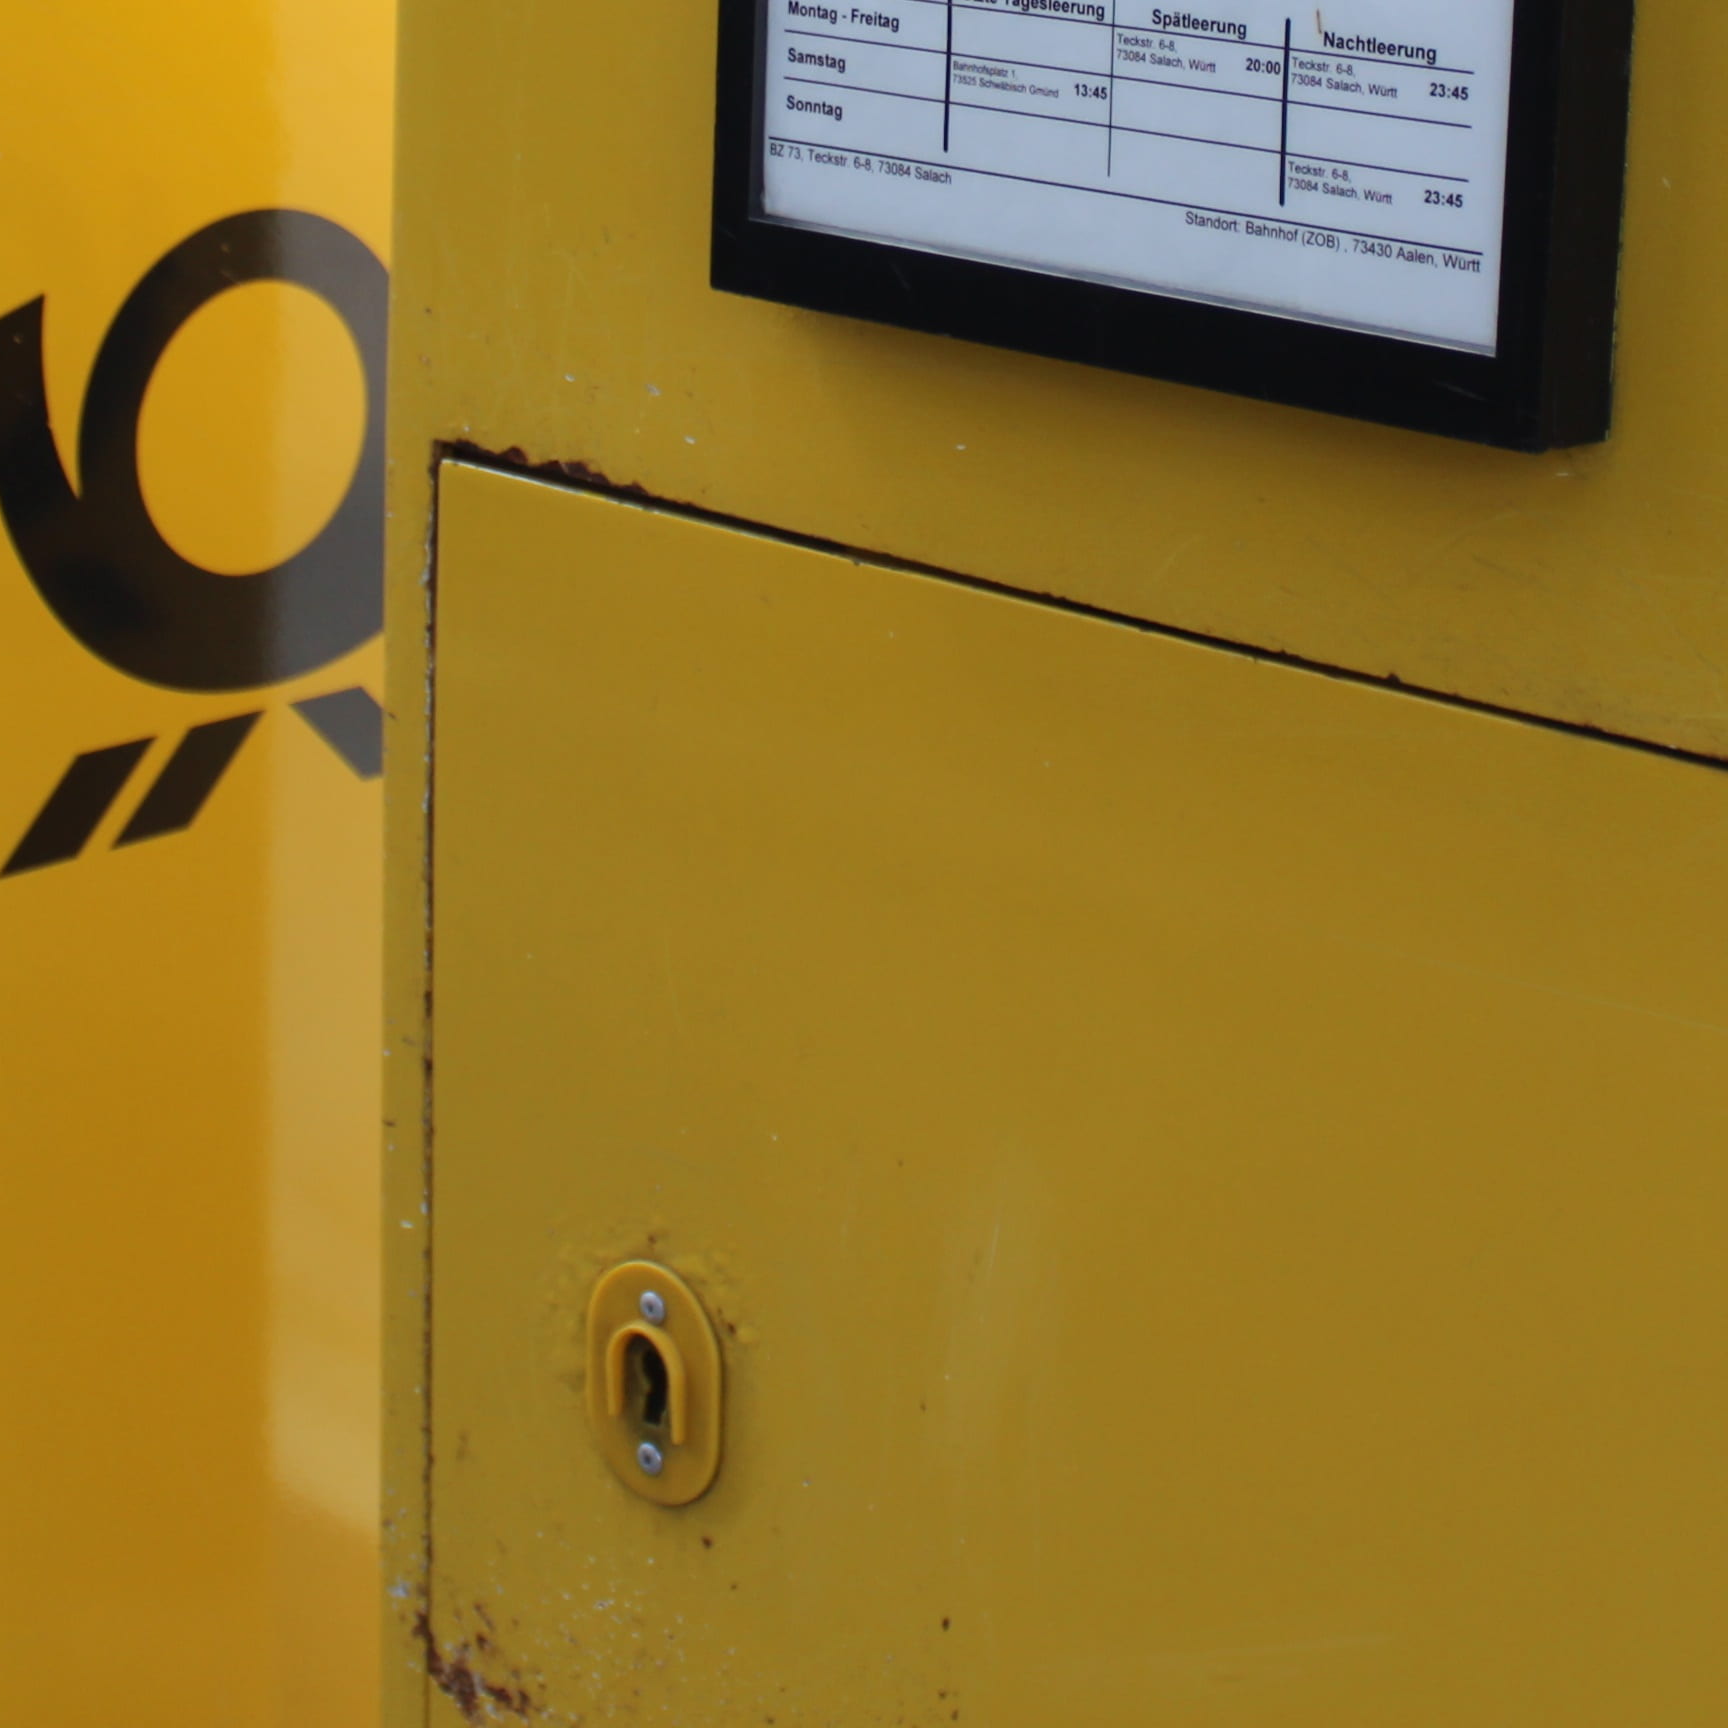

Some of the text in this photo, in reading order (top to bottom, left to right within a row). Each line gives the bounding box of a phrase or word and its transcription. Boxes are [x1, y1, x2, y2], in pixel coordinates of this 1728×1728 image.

[787, 0, 838, 25] Montag
[851, 7, 900, 33] Freitag
[1152, 8, 1248, 41] Spätleerung
[1115, 48, 1148, 64] 73084
[1323, 31, 1438, 66] Nachtleerung
[787, 48, 847, 74] Samstag
[1245, 57, 1282, 77] 20:00
[1074, 83, 1109, 101] 13:45
[1290, 72, 1323, 89] 73084
[1429, 82, 1470, 102] 23:45
[786, 95, 844, 121] Sonntag
[769, 142, 785, 158] BZ
[808, 148, 850, 168] Teckstr.
[878, 160, 912, 177] 73084
[914, 165, 953, 186] Salach
[1287, 177, 1320, 193] 73084
[1423, 190, 1464, 210] 23:45
[1185, 210, 1241, 234] Standort:
[1245, 221, 1299, 244] Bahnhof
[1301, 231, 1341, 253] (ZOB)
[1352, 238, 1393, 259] 73430
[1396, 246, 1439, 270] Aalen,
[1442, 253, 1482, 274] Württ
